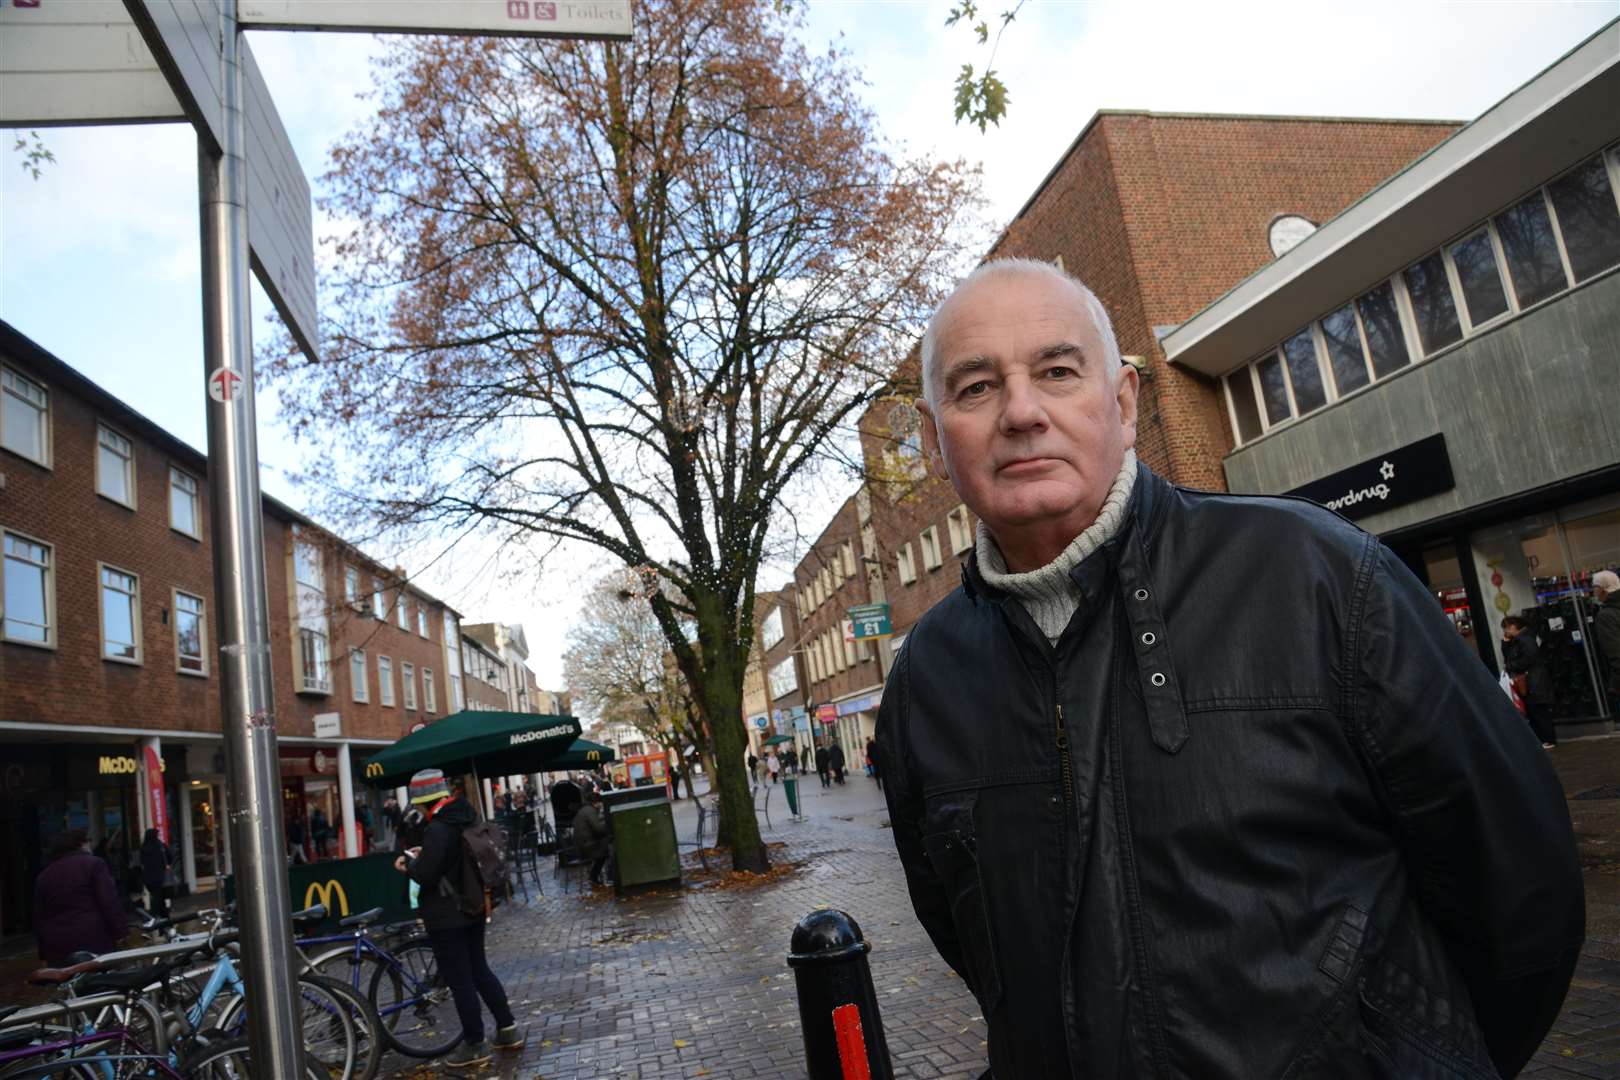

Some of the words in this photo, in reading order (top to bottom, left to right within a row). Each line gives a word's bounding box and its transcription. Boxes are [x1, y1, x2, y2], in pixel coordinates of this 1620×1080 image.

[562, 4, 623, 20] Toilets
[864, 622, 880, 635] £1
[510, 724, 574, 744] McDonald's
